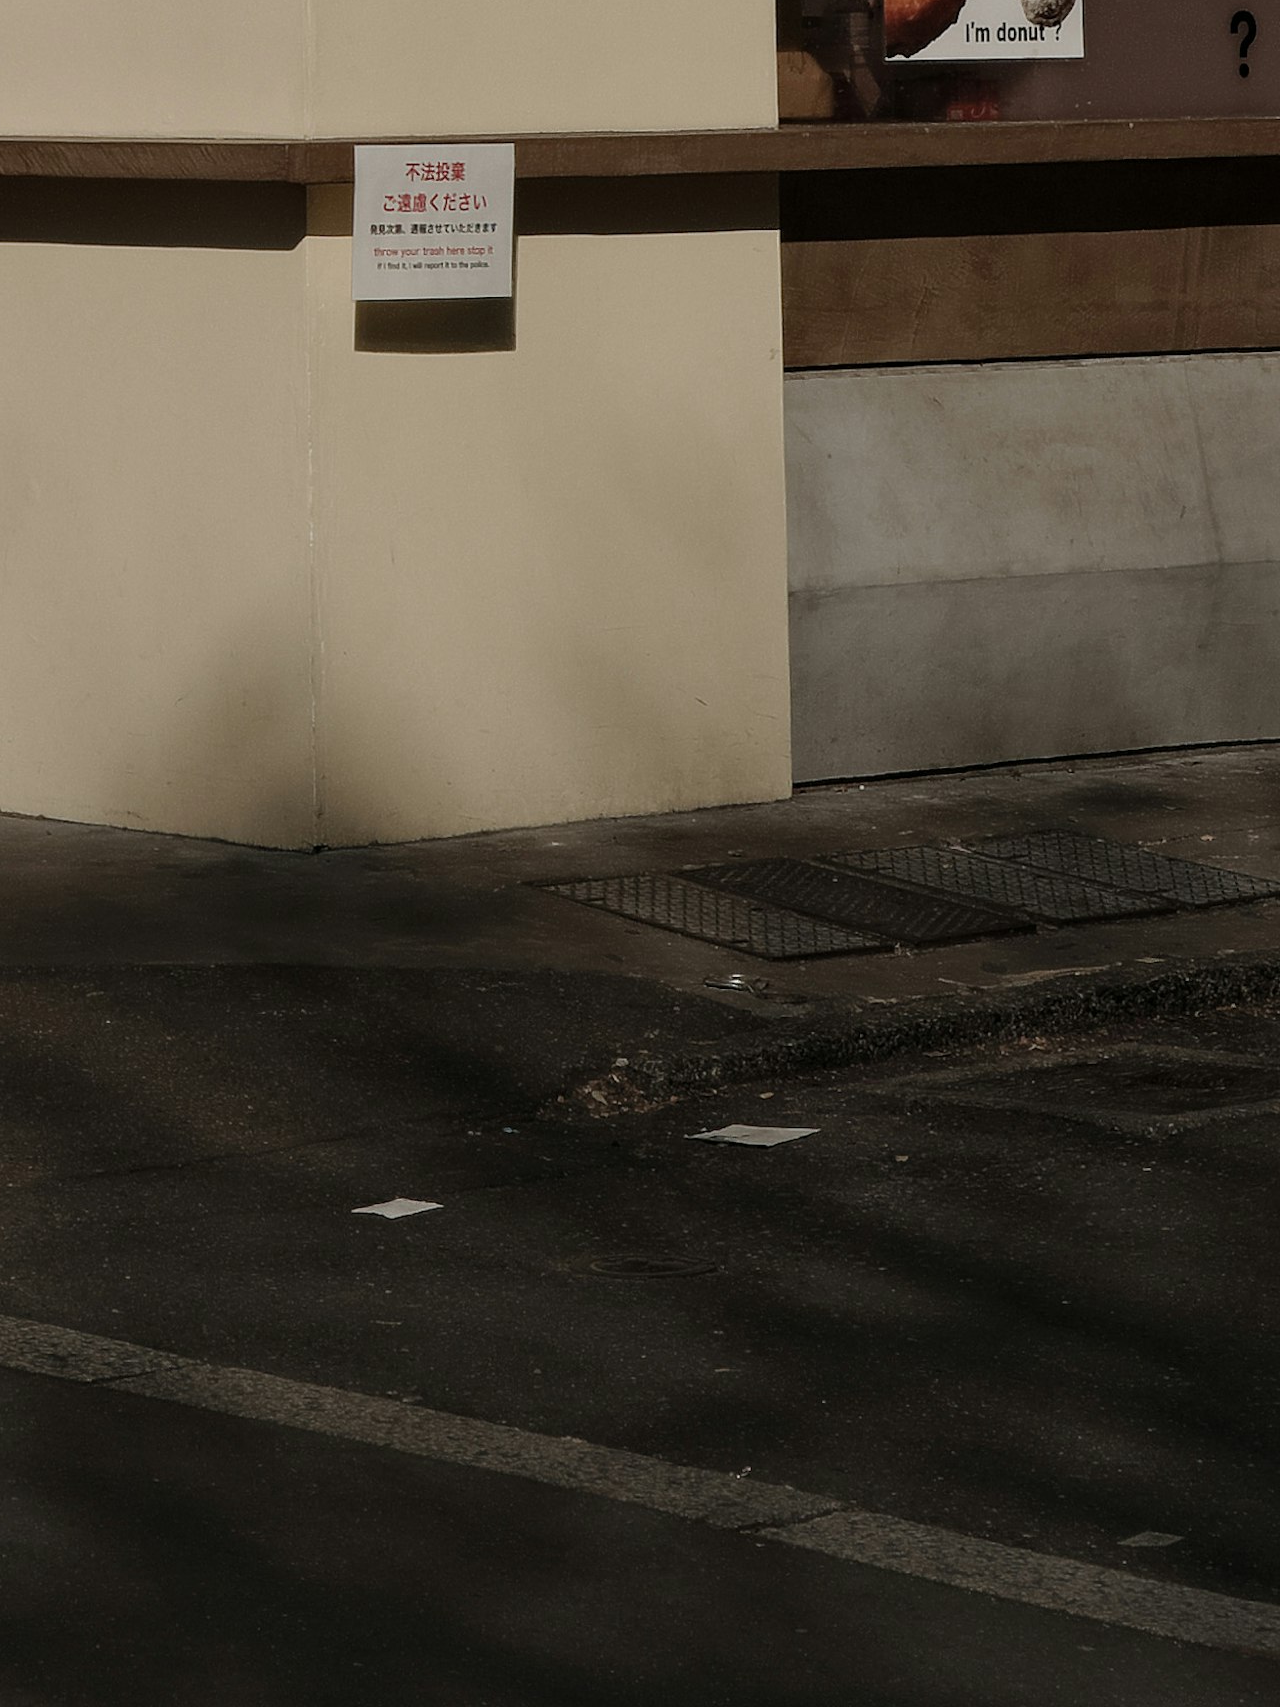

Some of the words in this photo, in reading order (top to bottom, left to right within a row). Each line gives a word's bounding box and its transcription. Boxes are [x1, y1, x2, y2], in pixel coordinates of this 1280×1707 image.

[965, 22, 990, 43] I'm
[997, 21, 1045, 43] donut
[1230, 10, 1257, 78] ?
[406, 162, 465, 182] 不法投棄
[383, 193, 487, 213] ご遠慮ください
